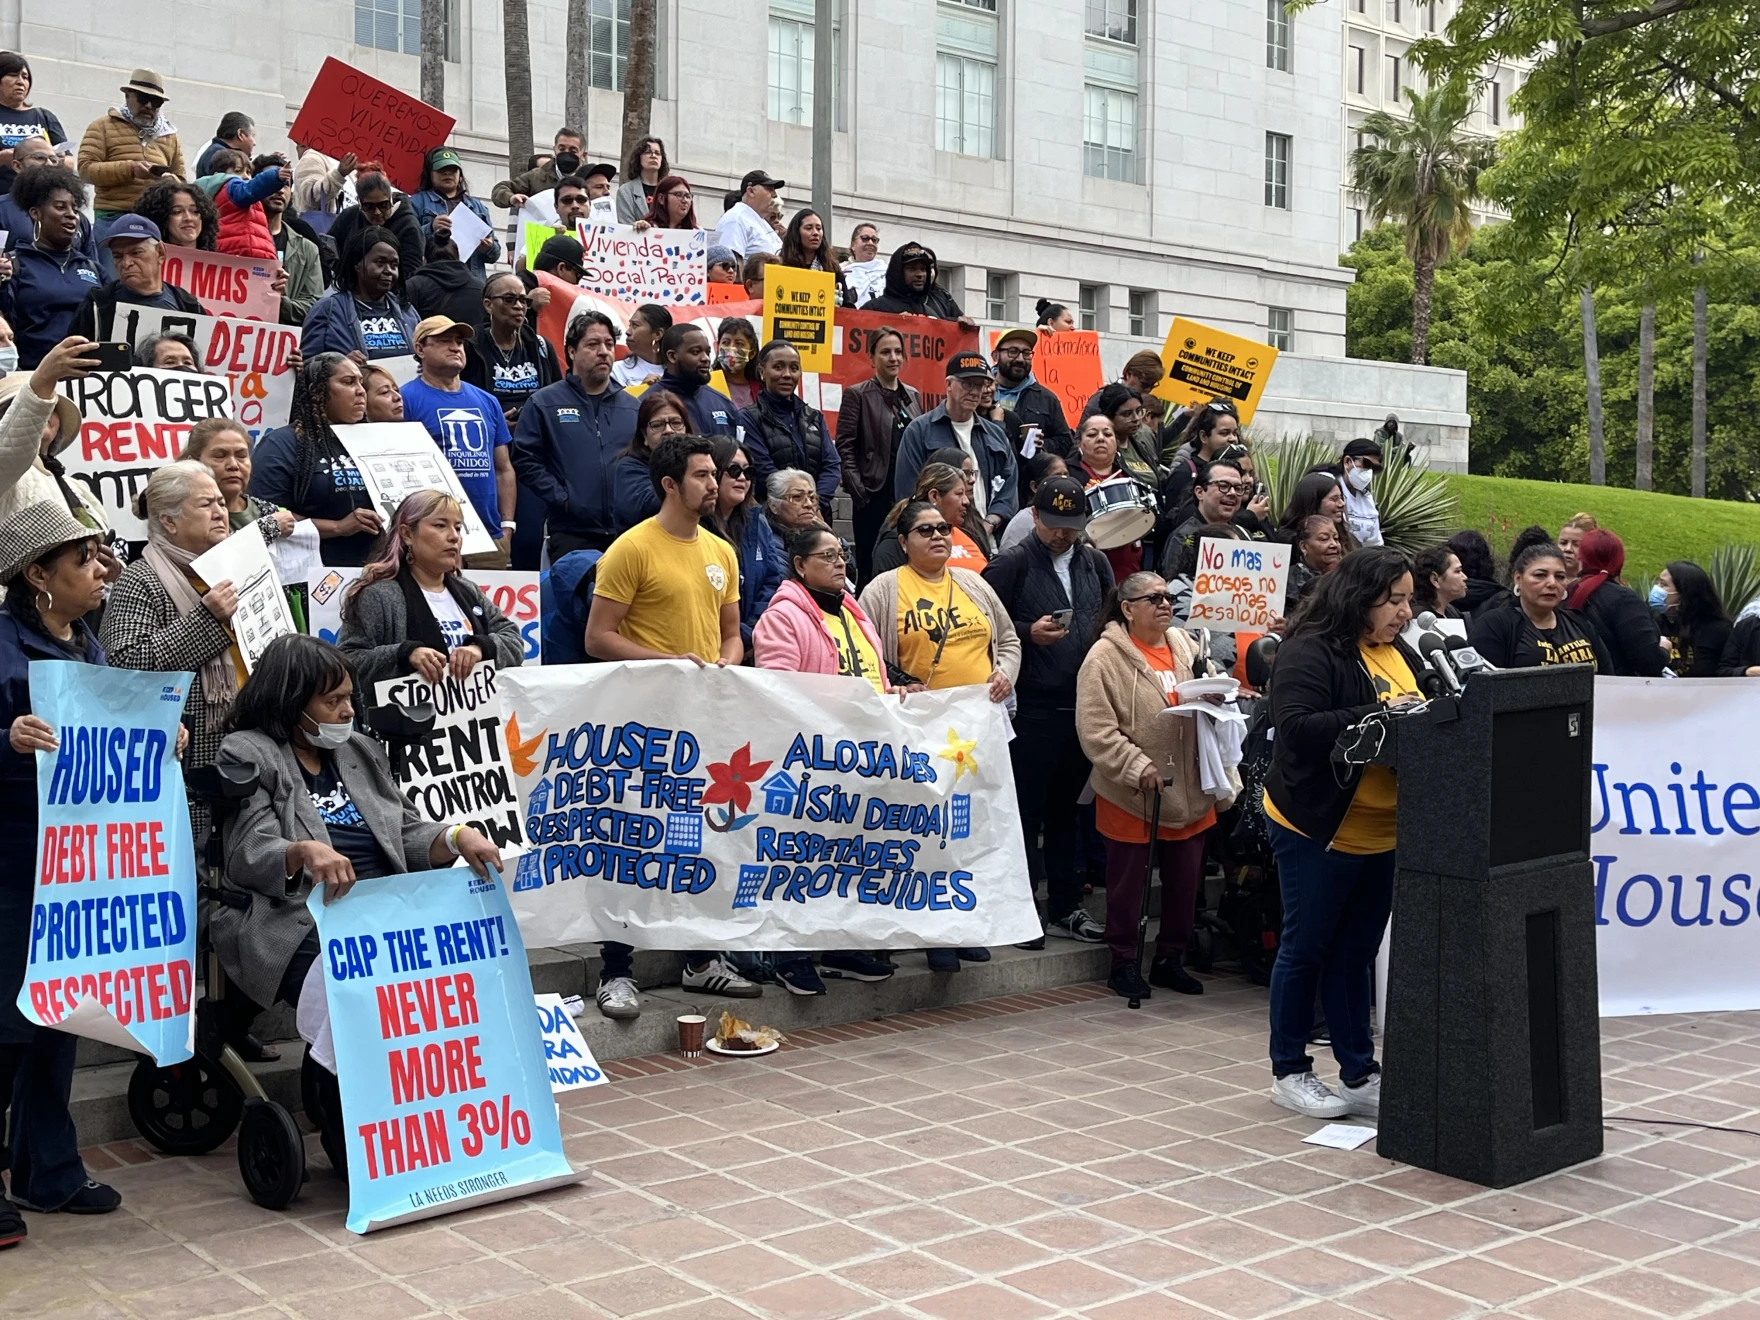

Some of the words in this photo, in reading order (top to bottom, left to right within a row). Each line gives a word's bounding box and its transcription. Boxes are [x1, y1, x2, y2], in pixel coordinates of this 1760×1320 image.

[341, 75, 442, 136] QUEREMOS
[350, 104, 427, 156] VIVIENDA
[318, 117, 395, 169] SOCIAL
[578, 222, 663, 258] Vivienda
[190, 261, 249, 305] MAS
[582, 258, 646, 284] Social
[651, 267, 699, 285] Para
[774, 302, 808, 316] COMMUNITIES
[809, 305, 826, 317] INTACT
[1178, 349, 1228, 372] COMMUNITIES
[1228, 365, 1255, 381] INTACT
[1205, 346, 1217, 358] WE
[1217, 350, 1235, 363] KEEP
[58, 371, 232, 422] TRONGER
[80, 421, 194, 462] RENT
[444, 420, 482, 452] IU
[449, 458, 489, 468] UNIDOS
[1200, 542, 1224, 570] No
[1231, 548, 1262, 571] mas
[1195, 573, 1253, 595] acosos
[1258, 576, 1276, 594] no
[1231, 592, 1267, 610] mas
[388, 664, 496, 716] STRONGER
[47, 725, 167, 806] HOUSED
[400, 717, 502, 783] RENT
[543, 721, 700, 775] HOUSED
[406, 766, 517, 822] CONTROL
[553, 767, 706, 813] DEBT-FREE
[1591, 761, 1760, 835] nite
[40, 824, 98, 886] DEBT
[106, 821, 169, 880] FREE
[526, 807, 664, 849] RESPECTED
[756, 826, 921, 871] RESPETADES
[543, 842, 716, 895] PROTECTED
[29, 890, 187, 965] PROTECTED
[328, 934, 378, 982] CAP
[383, 927, 432, 975] THE
[434, 915, 509, 966] RENT!
[376, 972, 479, 1040] NEVER
[388, 1036, 486, 1105] MORE
[358, 1109, 451, 1181] THAN
[457, 1094, 531, 1157] 3%
[409, 1192, 424, 1209] LA
[423, 1182, 458, 1205] NEEDS
[457, 1171, 509, 1198] STRONGER
